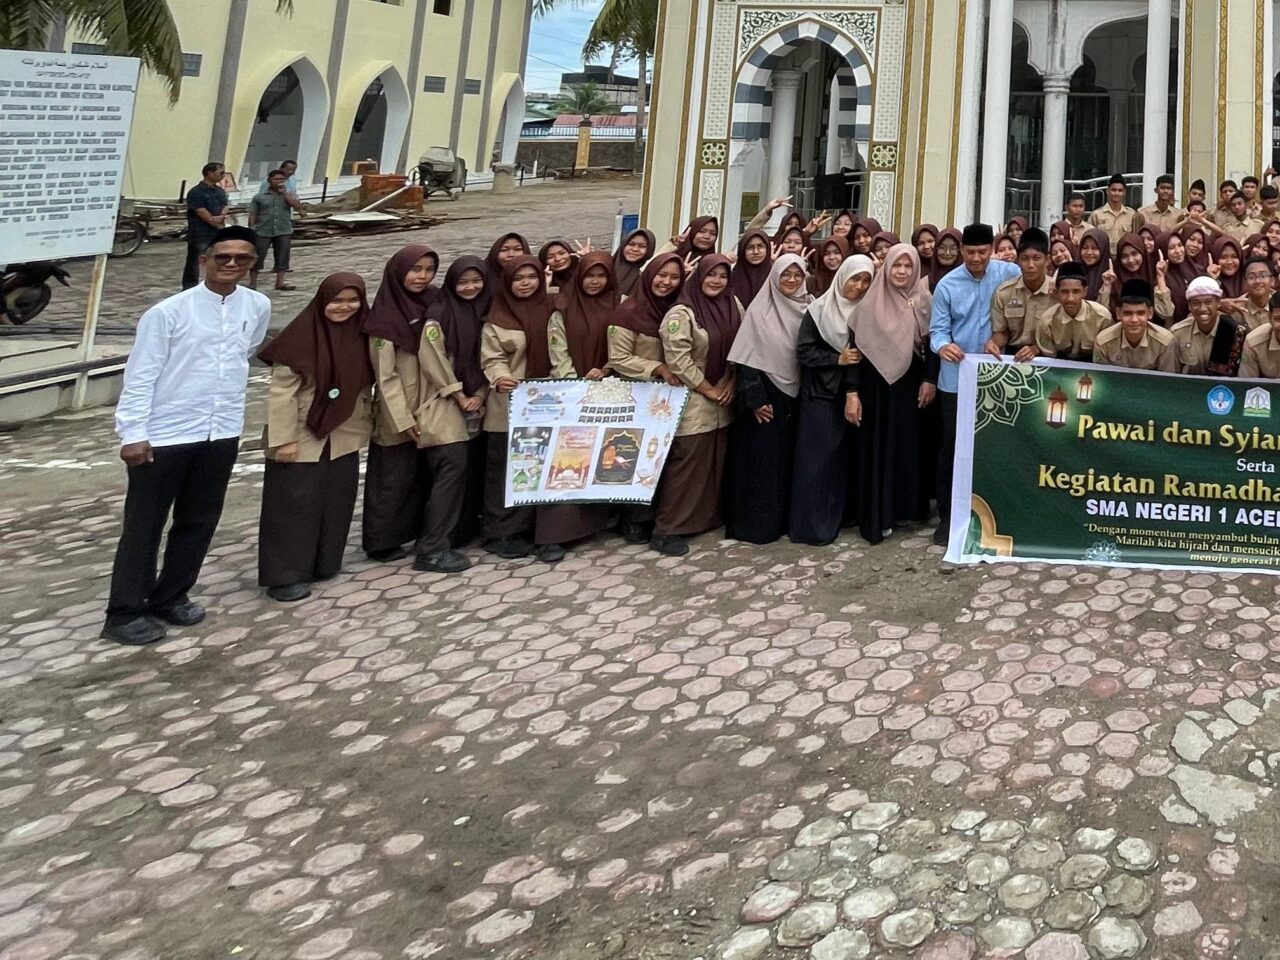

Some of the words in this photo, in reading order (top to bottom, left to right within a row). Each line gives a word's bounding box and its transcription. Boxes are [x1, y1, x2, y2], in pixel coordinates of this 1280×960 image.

[1077, 414, 1155, 442] Pawai
[1162, 421, 1211, 446] dan
[1236, 458, 1275, 474] Serta
[1038, 464, 1155, 497] Kegiatan
[1086, 499, 1129, 518] SMA
[1135, 501, 1211, 522] NEGERI
[1218, 507, 1227, 523] 1
[1115, 535, 1155, 547] Marilah
[1157, 538, 1176, 548] kita
[1178, 540, 1209, 552] hijrah
[1211, 542, 1230, 552] dan
[1129, 528, 1186, 539] momentum
[1188, 531, 1248, 543] menyambut
[1250, 533, 1279, 545] bulan
[1190, 553, 1228, 564] menuju
[1230, 556, 1272, 565] generasi
